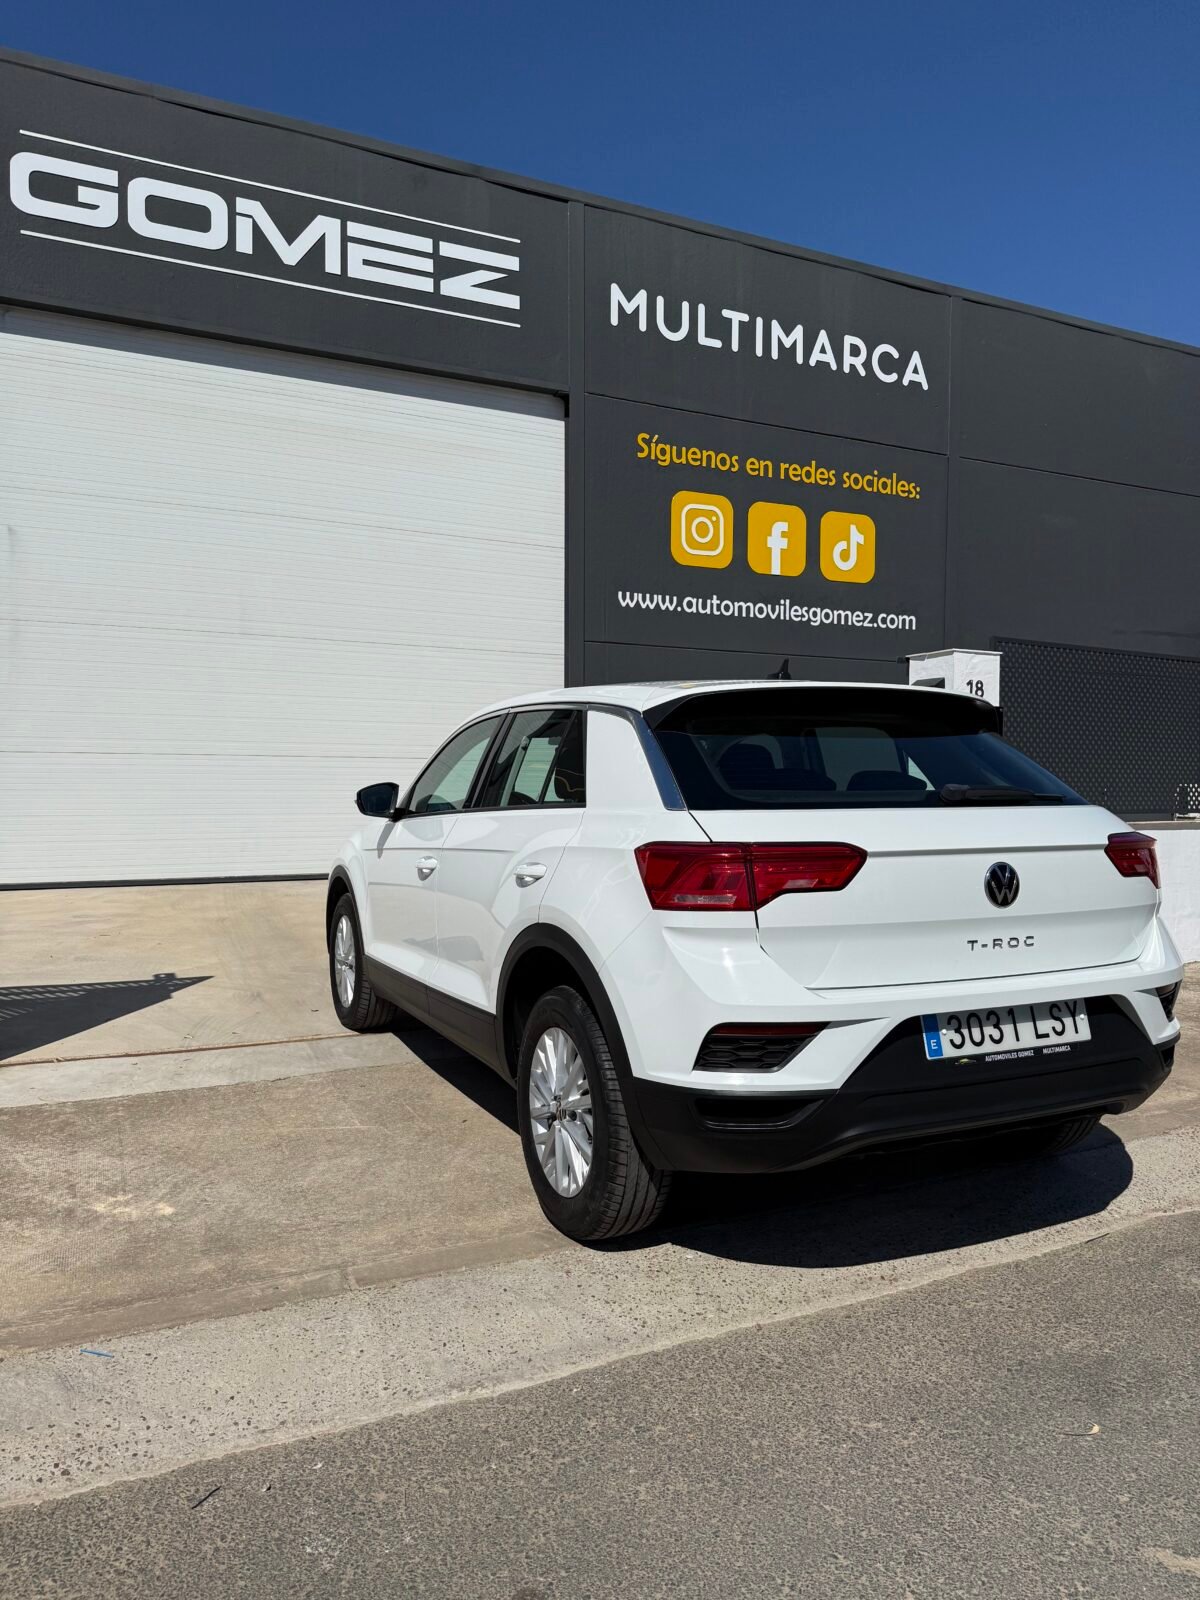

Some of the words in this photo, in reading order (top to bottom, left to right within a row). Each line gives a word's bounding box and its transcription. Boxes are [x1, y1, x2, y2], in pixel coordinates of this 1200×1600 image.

[10, 151, 520, 310] GOMEZ
[610, 282, 929, 391] MULTIMARCA
[636, 432, 739, 473] Síguenos
[745, 457, 773, 478] en
[779, 460, 836, 487] redes
[842, 470, 921, 500] sociales:
[617, 589, 917, 631] www.automovilesgomez.com
[966, 679, 985, 698] 18
[966, 935, 1035, 951] T-ROC
[930, 1039, 938, 1050] E
[947, 1007, 1020, 1050] 3031
[1030, 999, 1080, 1041] LSY
[985, 1050, 1018, 1062] AUTOMOVILES
[1018, 1049, 1035, 1058] GOMEZ
[1042, 1044, 1071, 1054] MULTIMARCA
